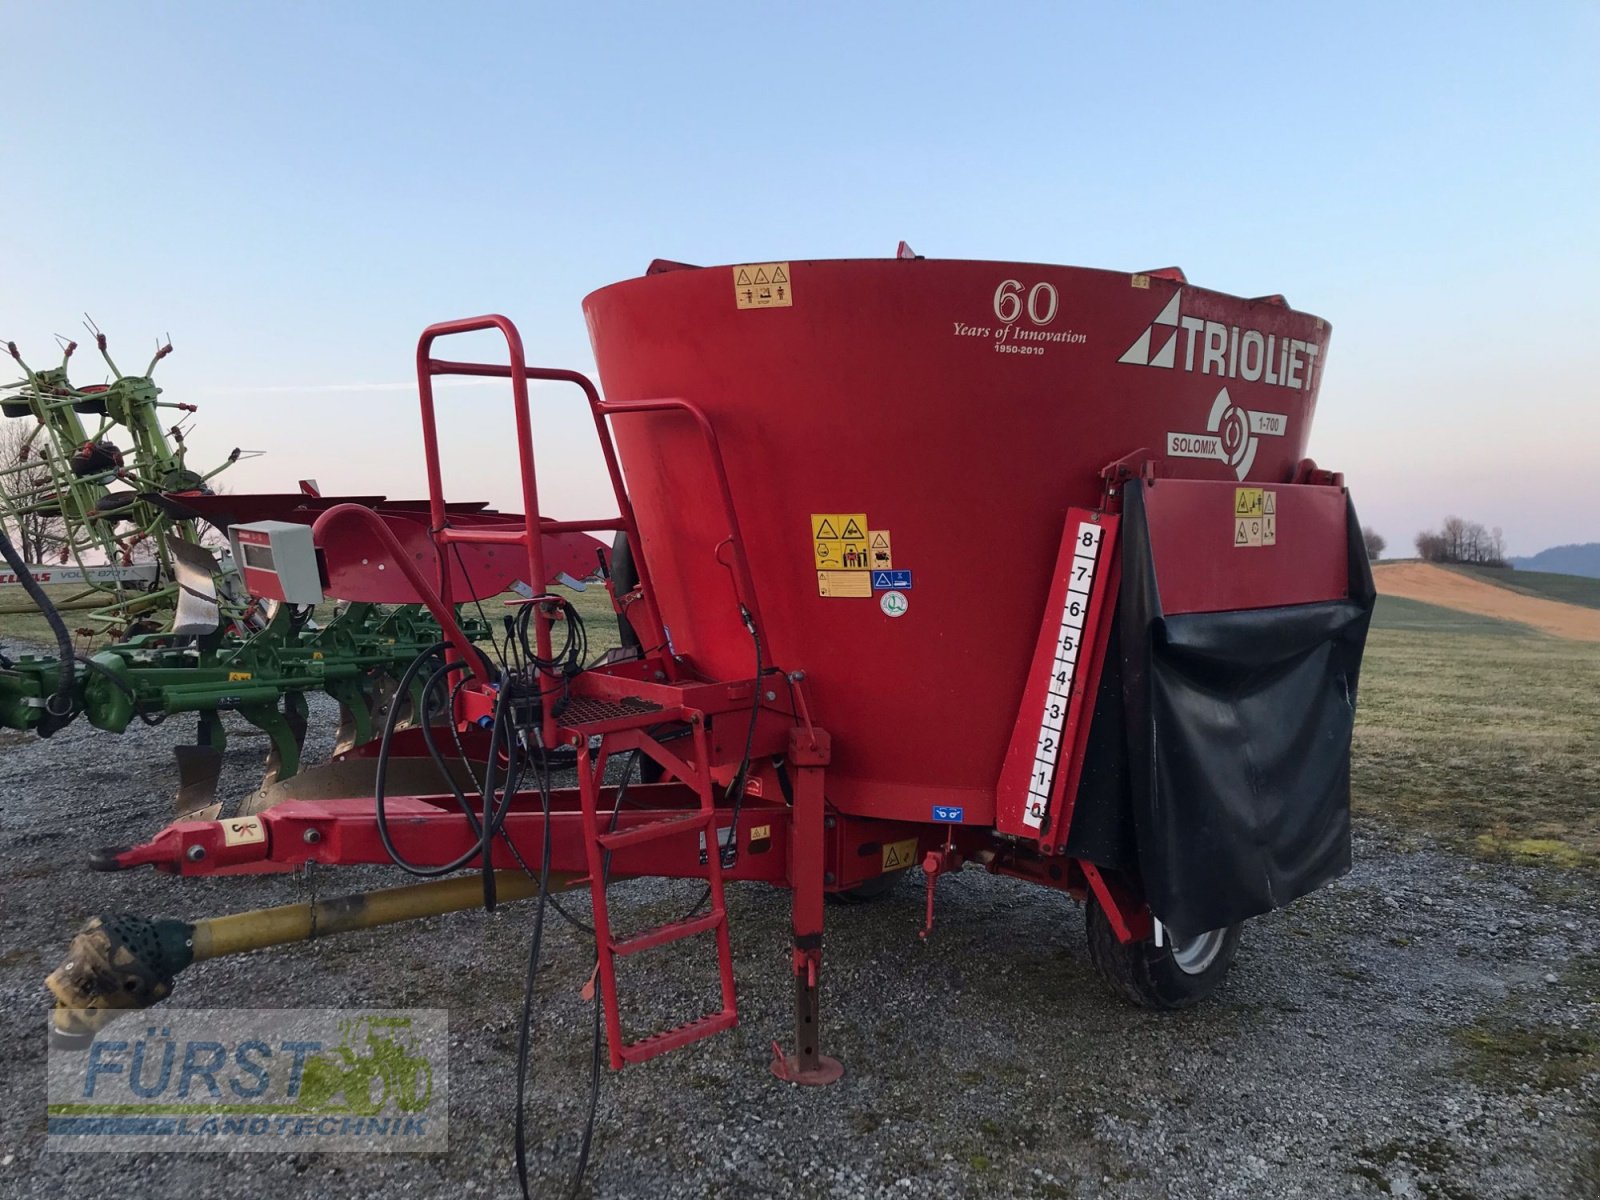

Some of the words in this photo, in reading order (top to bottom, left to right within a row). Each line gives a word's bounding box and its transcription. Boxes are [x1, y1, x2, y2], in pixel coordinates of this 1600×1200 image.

[993, 279, 1059, 326] 60
[953, 322, 991, 338] Years
[994, 323, 1013, 345] of
[1012, 326, 1087, 344] Innovation
[994, 344, 1045, 355] 1950-2010
[1181, 314, 1320, 391] TRIOLIET
[1258, 416, 1280, 432] 1-700
[1172, 437, 1218, 456] SOLOMIX
[1082, 532, 1093, 546] 8
[1077, 567, 1087, 581] 7
[1069, 602, 1080, 616] 6
[1063, 636, 1074, 651] 5
[1056, 670, 1067, 686] 4
[1049, 705, 1060, 719] 3
[1043, 738, 1054, 753] 2
[1039, 771, 1046, 786] 1
